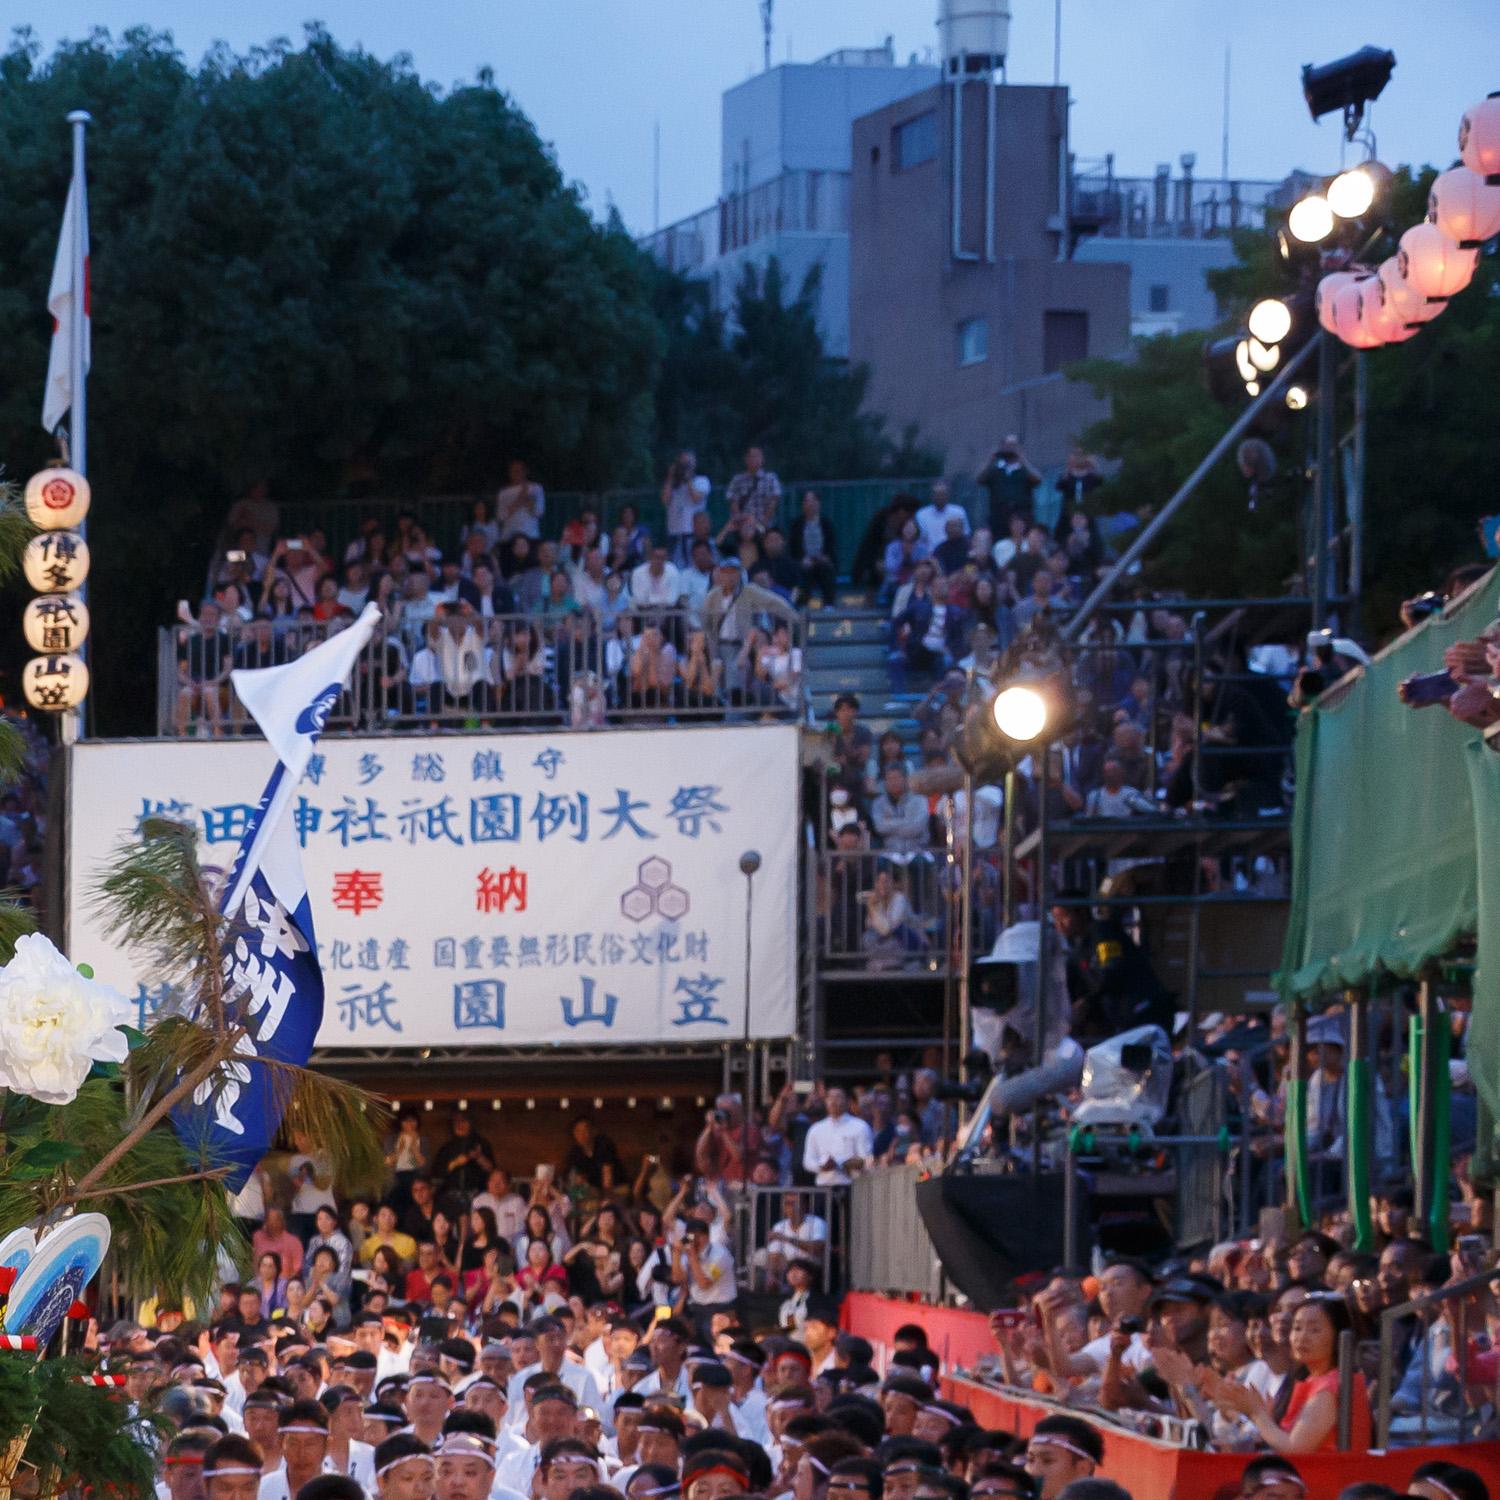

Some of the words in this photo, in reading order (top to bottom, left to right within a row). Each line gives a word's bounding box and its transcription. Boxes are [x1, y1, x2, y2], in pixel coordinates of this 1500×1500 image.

[332, 866, 527, 916] 奉納
[433, 931, 711, 970] 国重要無形民俗文化財
